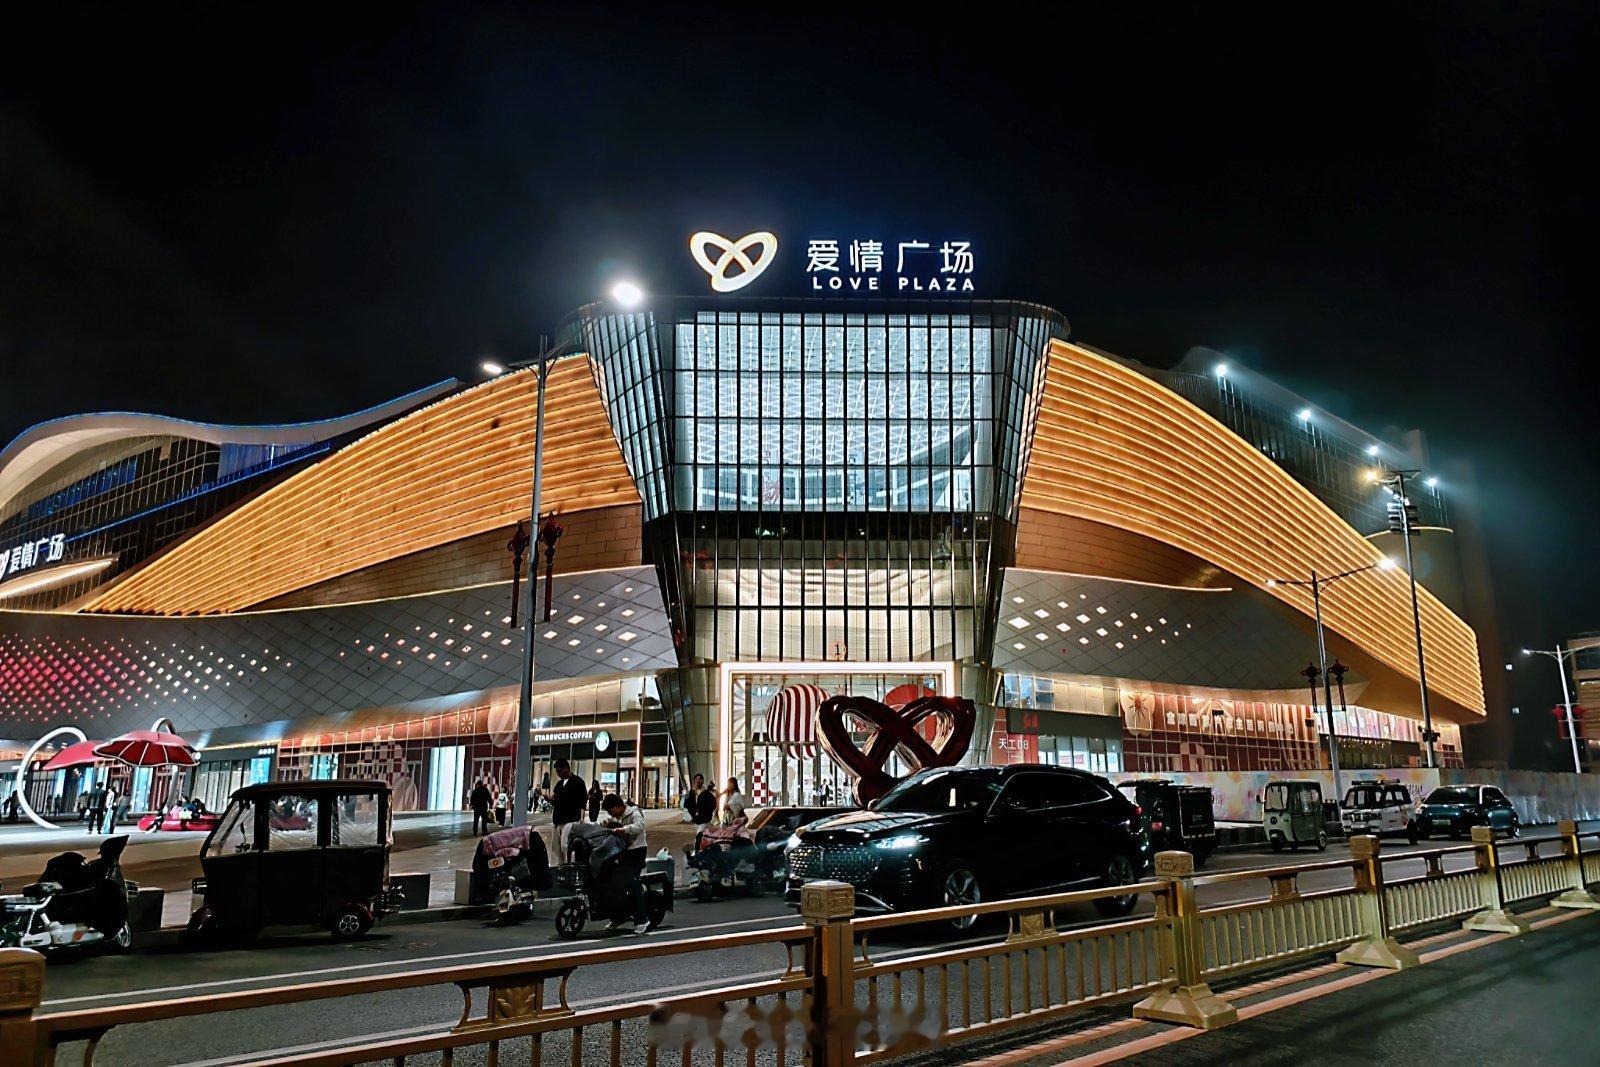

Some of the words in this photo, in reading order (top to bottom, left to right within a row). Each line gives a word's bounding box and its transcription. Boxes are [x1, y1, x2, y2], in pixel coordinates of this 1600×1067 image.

[806, 239, 974, 274] 爱情广场
[812, 277, 879, 291] LOVE
[898, 277, 975, 291] PLAZA
[9, 533, 66, 574] 爱情广场
[534, 732, 570, 742] STARBUCKS
[569, 731, 593, 740] COFFEE
